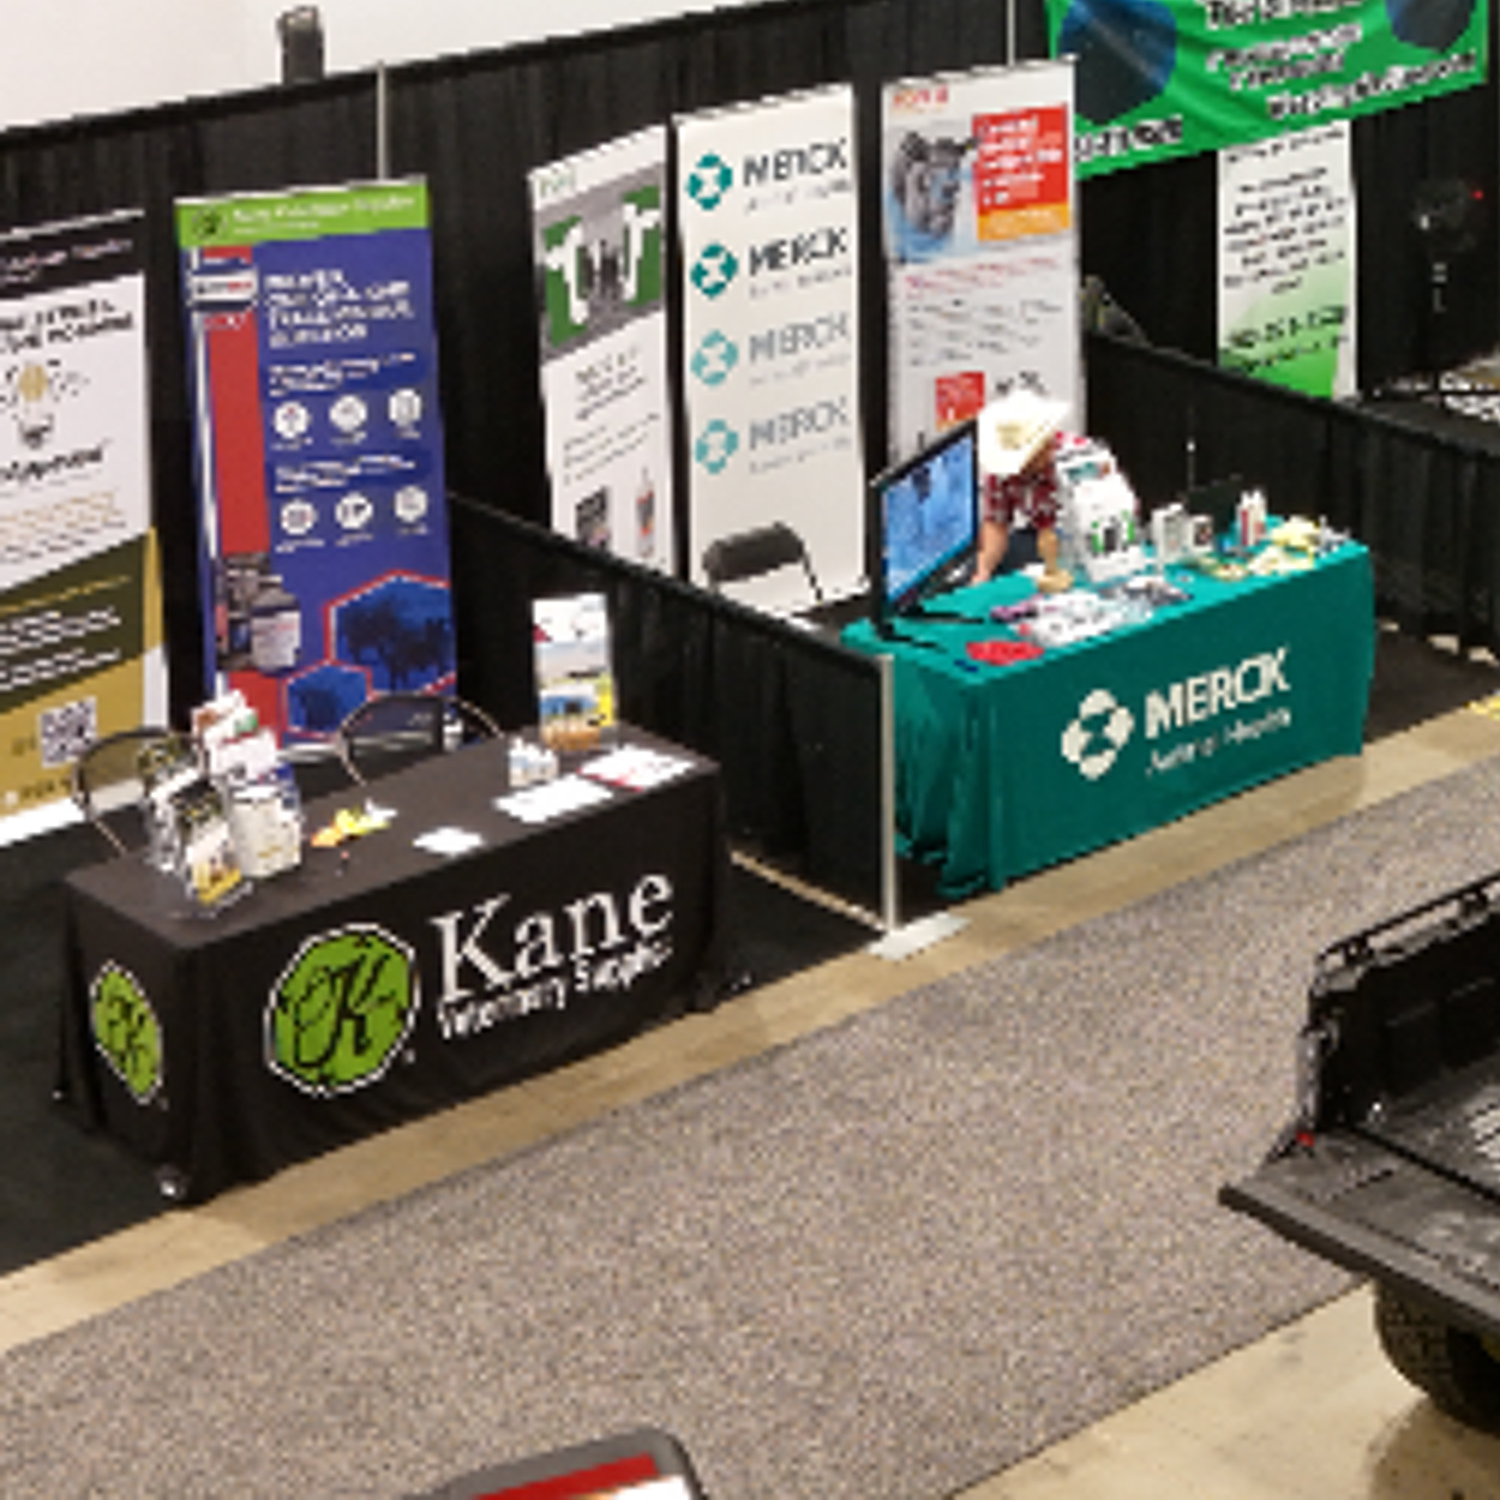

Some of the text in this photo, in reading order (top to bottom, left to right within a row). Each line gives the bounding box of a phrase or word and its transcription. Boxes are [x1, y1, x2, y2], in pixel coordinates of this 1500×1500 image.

[743, 137, 848, 187] MERCK
[748, 226, 848, 277] MERCK
[1145, 645, 1291, 740] MERCK
[429, 872, 674, 1002] Kane
